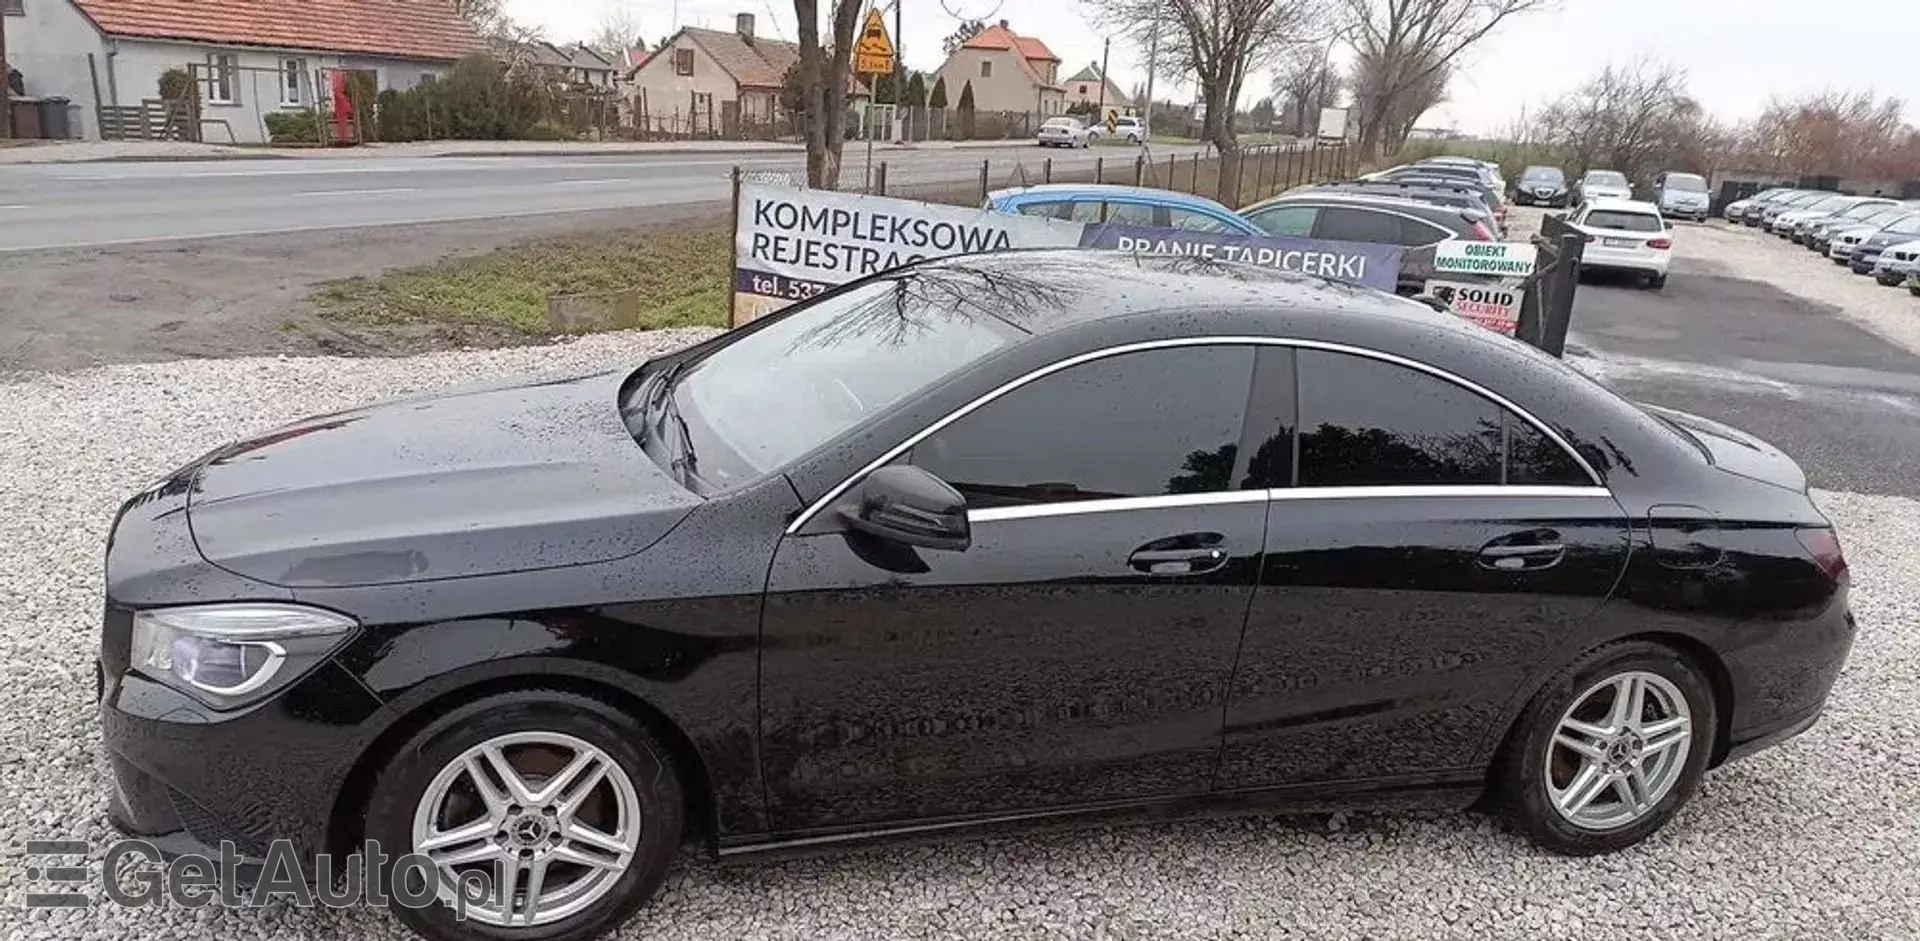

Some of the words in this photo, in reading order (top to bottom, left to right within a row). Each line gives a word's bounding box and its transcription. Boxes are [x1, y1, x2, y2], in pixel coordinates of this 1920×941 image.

[754, 199, 1012, 251] KOMPLEKSOWA
[1465, 244, 1507, 257] OBIEKT
[1223, 245, 1366, 279] TAPICERKI
[1437, 257, 1532, 273] MONITOROWANY
[753, 276, 783, 296] tel.
[1458, 288, 1513, 306] SOLID
[1457, 302, 1509, 317] SECURITY
